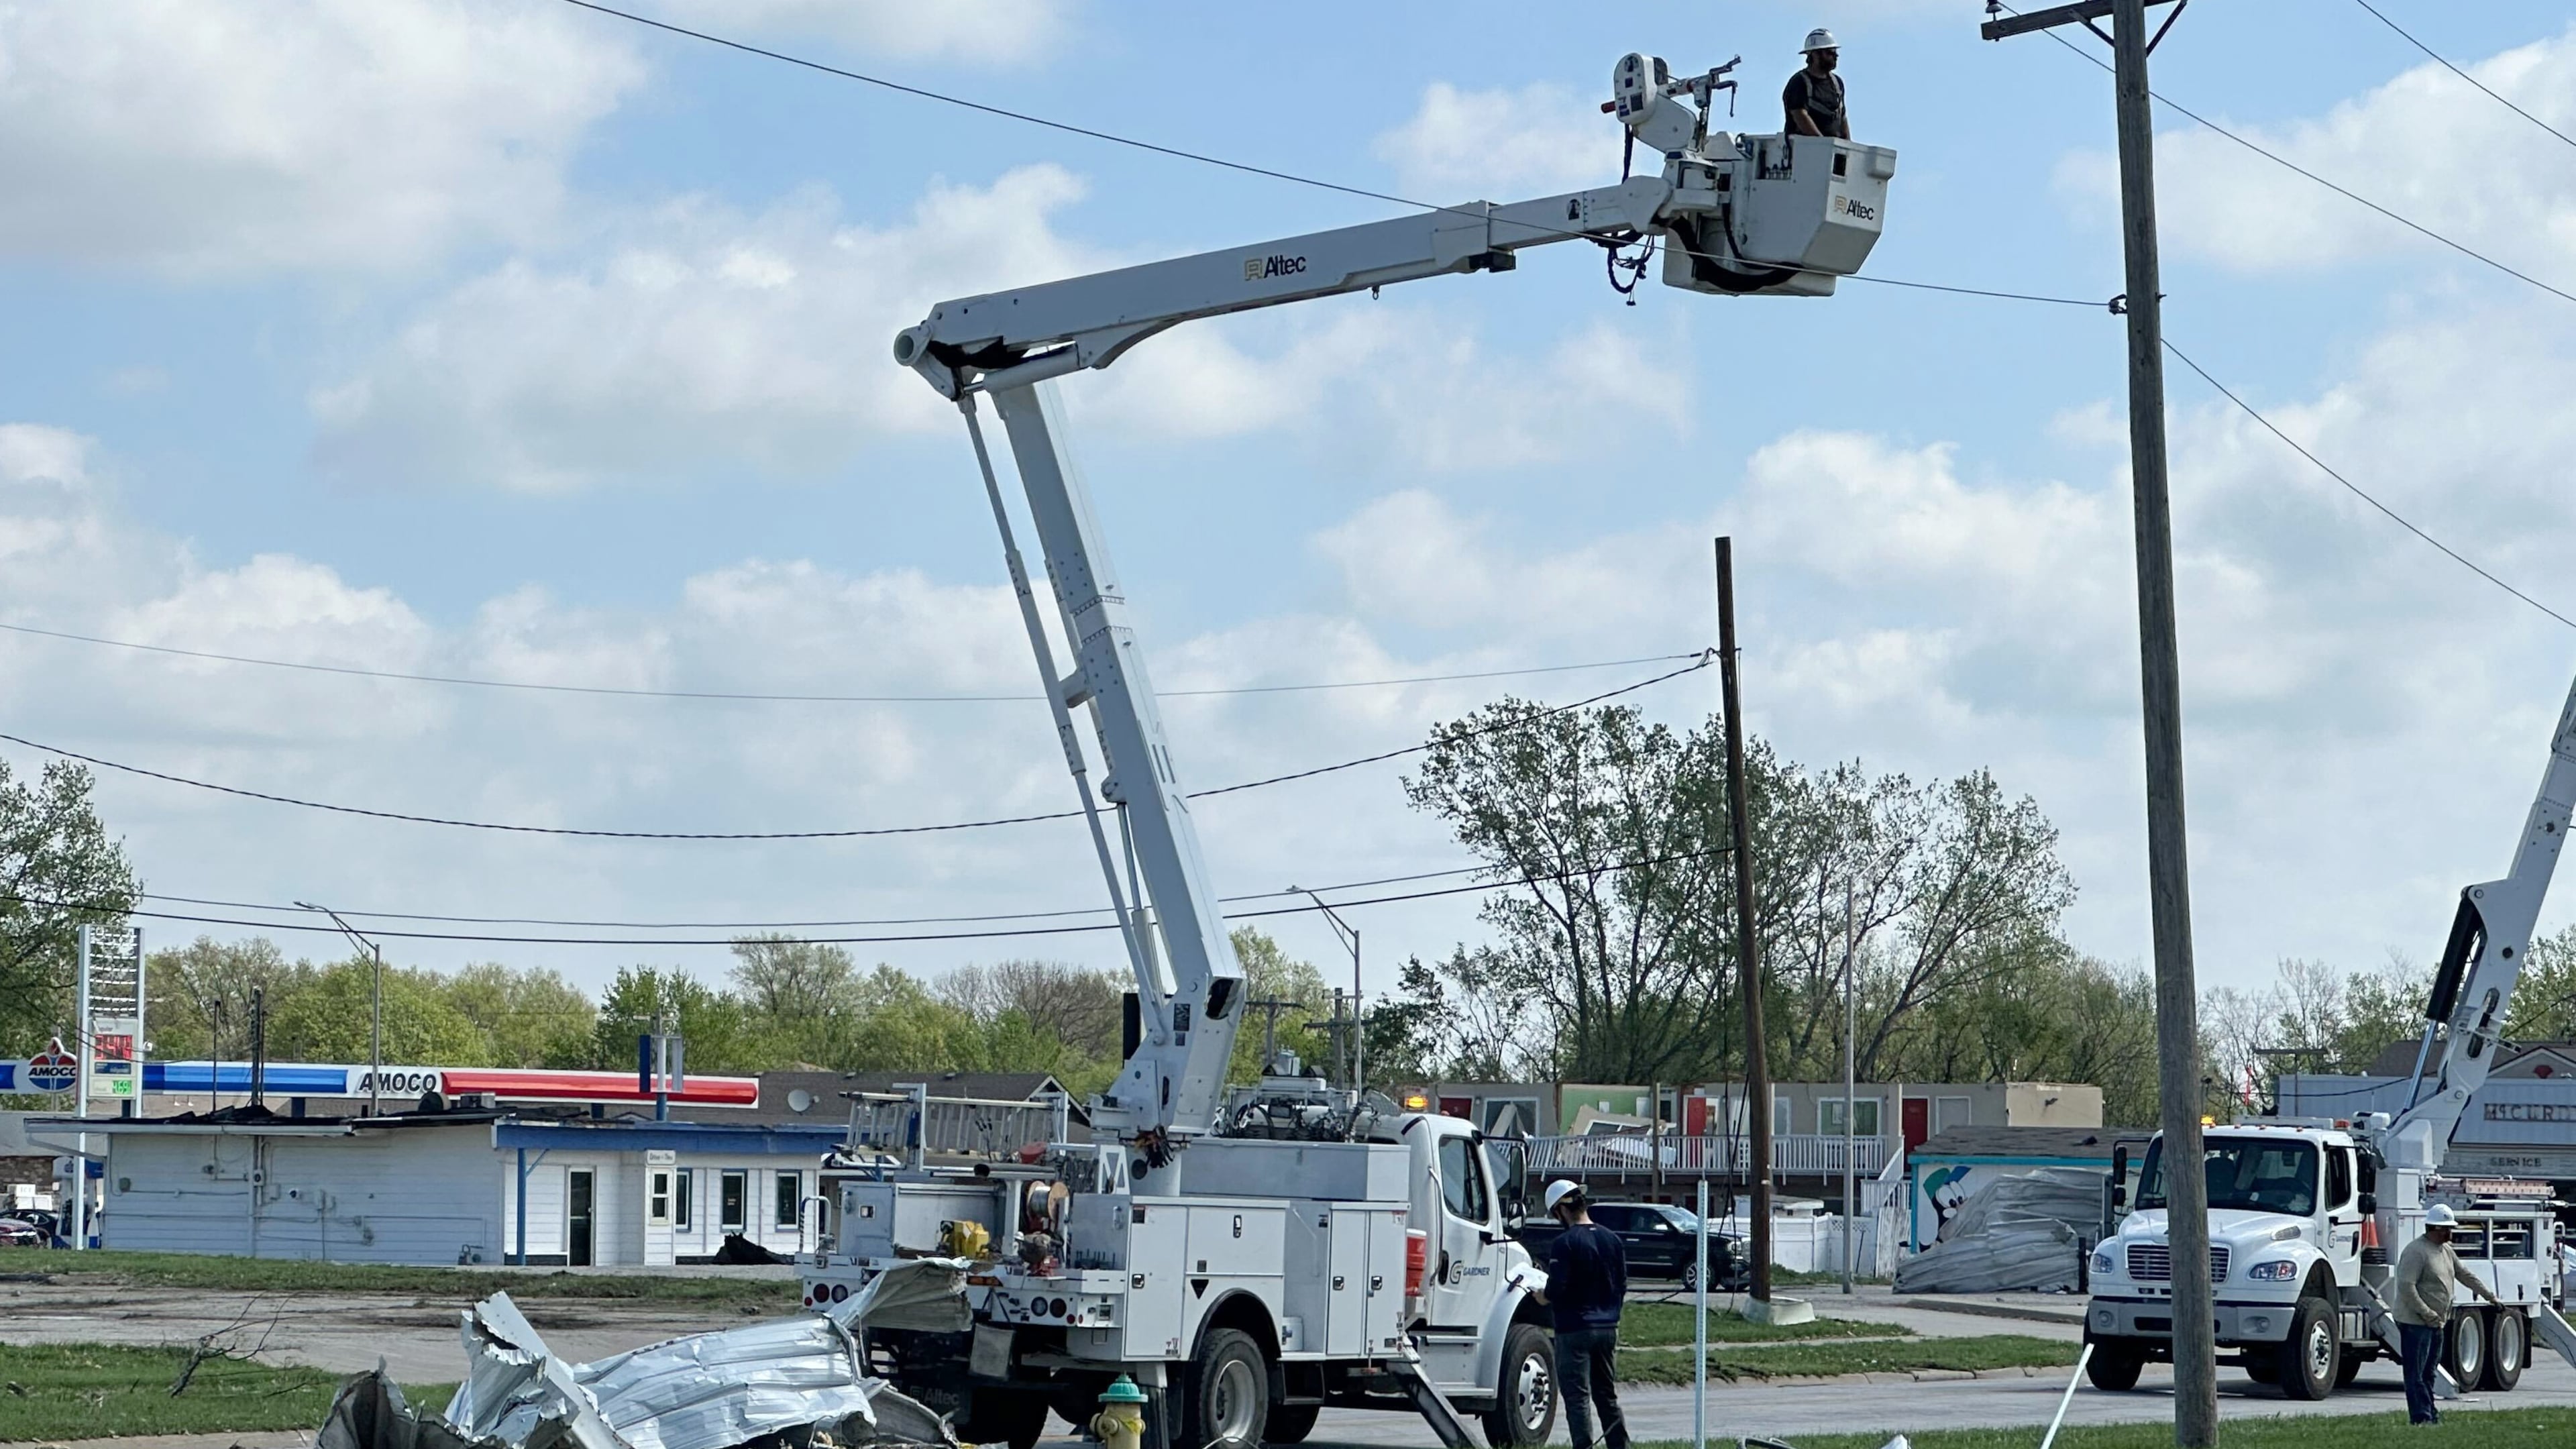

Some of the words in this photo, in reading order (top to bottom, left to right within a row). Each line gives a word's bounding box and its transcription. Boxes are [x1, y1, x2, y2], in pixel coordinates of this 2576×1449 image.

[1846, 199, 1874, 220] Altec
[1263, 255, 1307, 278] Altec
[359, 1073, 436, 1091] AMOCO
[924, 1387, 960, 1405] Altec
